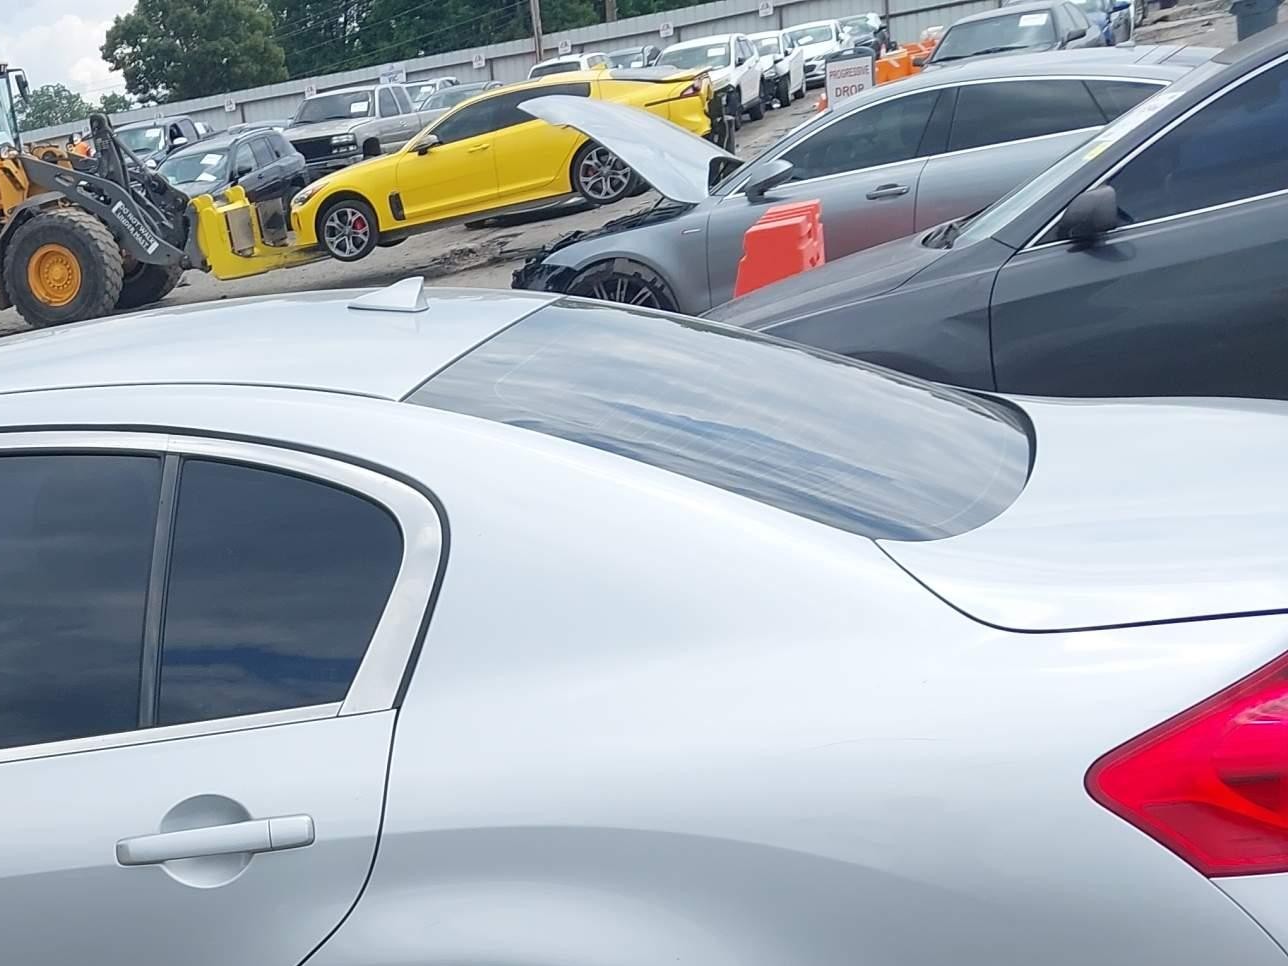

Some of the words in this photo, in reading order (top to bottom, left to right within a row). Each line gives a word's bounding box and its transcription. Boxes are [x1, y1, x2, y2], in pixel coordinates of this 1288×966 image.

[835, 83, 864, 98] DROP
[120, 204, 129, 214] DO
[127, 213, 142, 227] NOT
